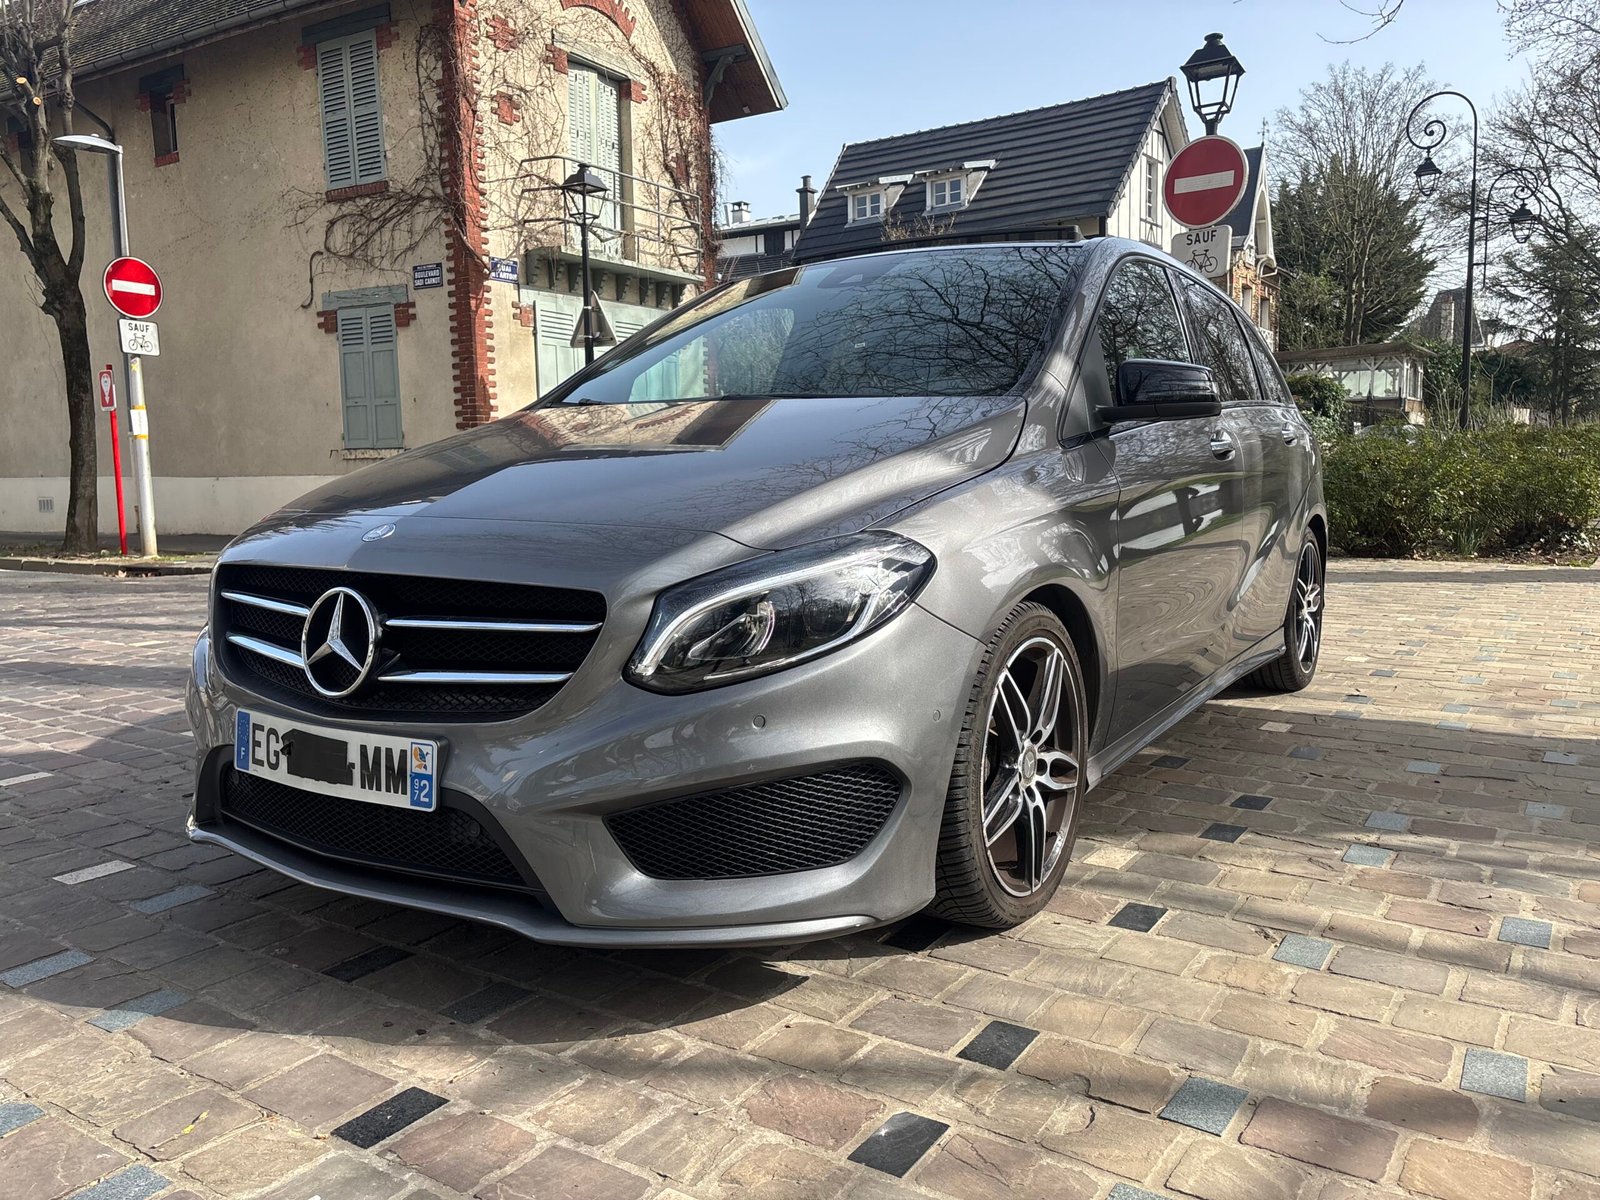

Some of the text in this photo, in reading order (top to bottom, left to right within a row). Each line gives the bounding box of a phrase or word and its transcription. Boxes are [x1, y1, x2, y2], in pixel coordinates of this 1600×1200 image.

[1186, 230, 1217, 246] SAUF
[414, 269, 440, 279] BOULEVARD
[424, 276, 441, 285] CARNOT
[128, 322, 150, 333] SAUF
[240, 746, 245, 760] F
